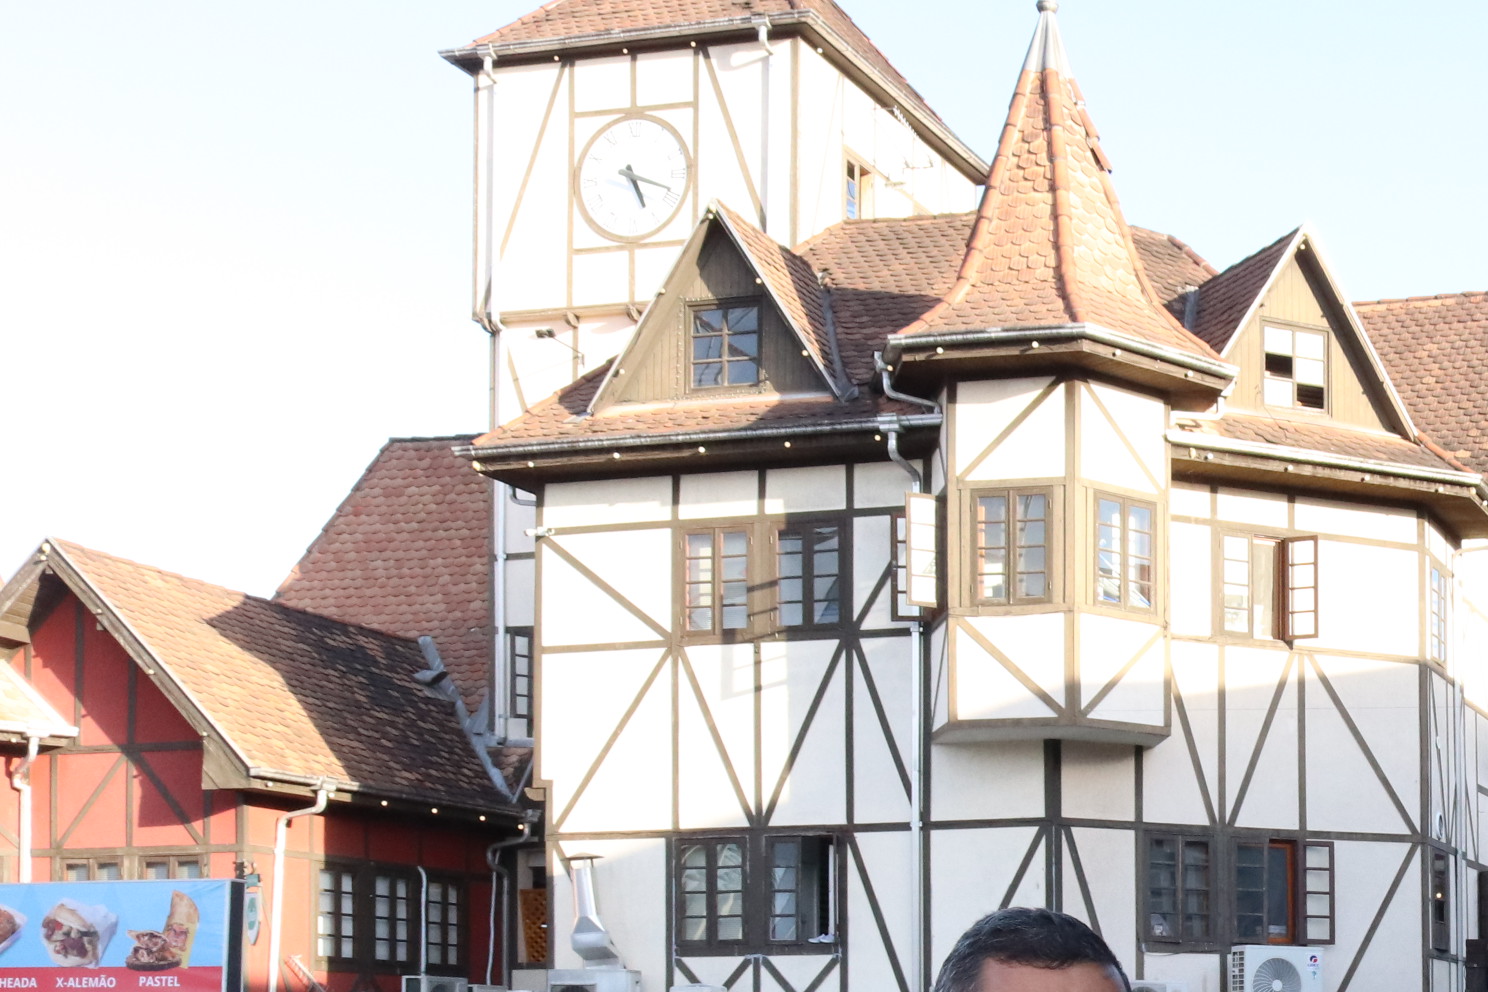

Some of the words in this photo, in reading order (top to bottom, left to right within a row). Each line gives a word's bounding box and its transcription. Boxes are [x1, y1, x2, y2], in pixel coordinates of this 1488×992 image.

[0, 977, 37, 988] HEADA
[55, 975, 116, 988] X-ALEMÃO
[139, 976, 180, 987] PASTEL
